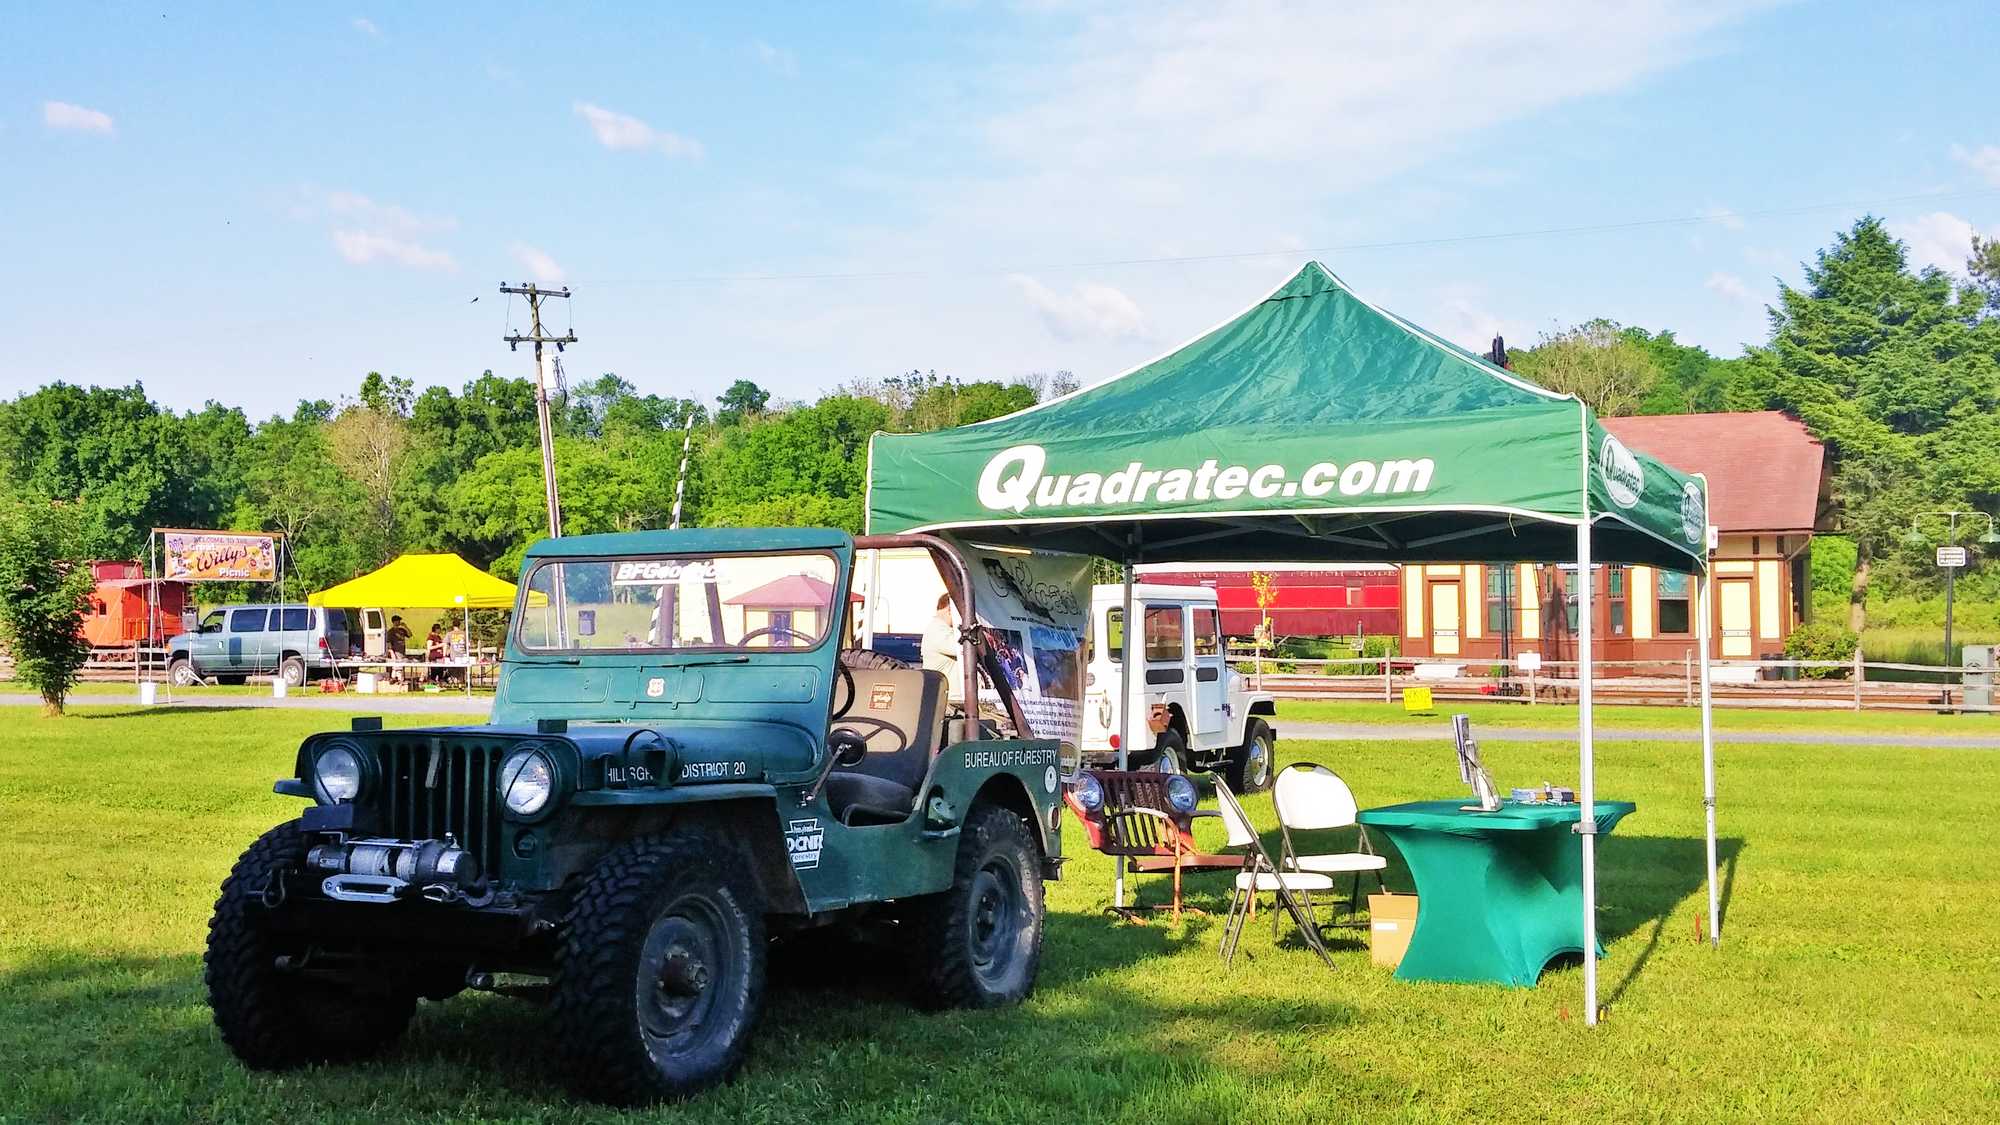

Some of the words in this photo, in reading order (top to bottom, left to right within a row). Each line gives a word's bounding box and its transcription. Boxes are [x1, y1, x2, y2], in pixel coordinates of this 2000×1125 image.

[977, 444, 1435, 514] Quadratec.com
[965, 751, 1000, 768] BUREAU
[1001, 751, 1014, 766] OF
[1014, 749, 1057, 766] FORESTRY
[682, 762, 729, 778] DISTRICT
[733, 761, 746, 775] 20
